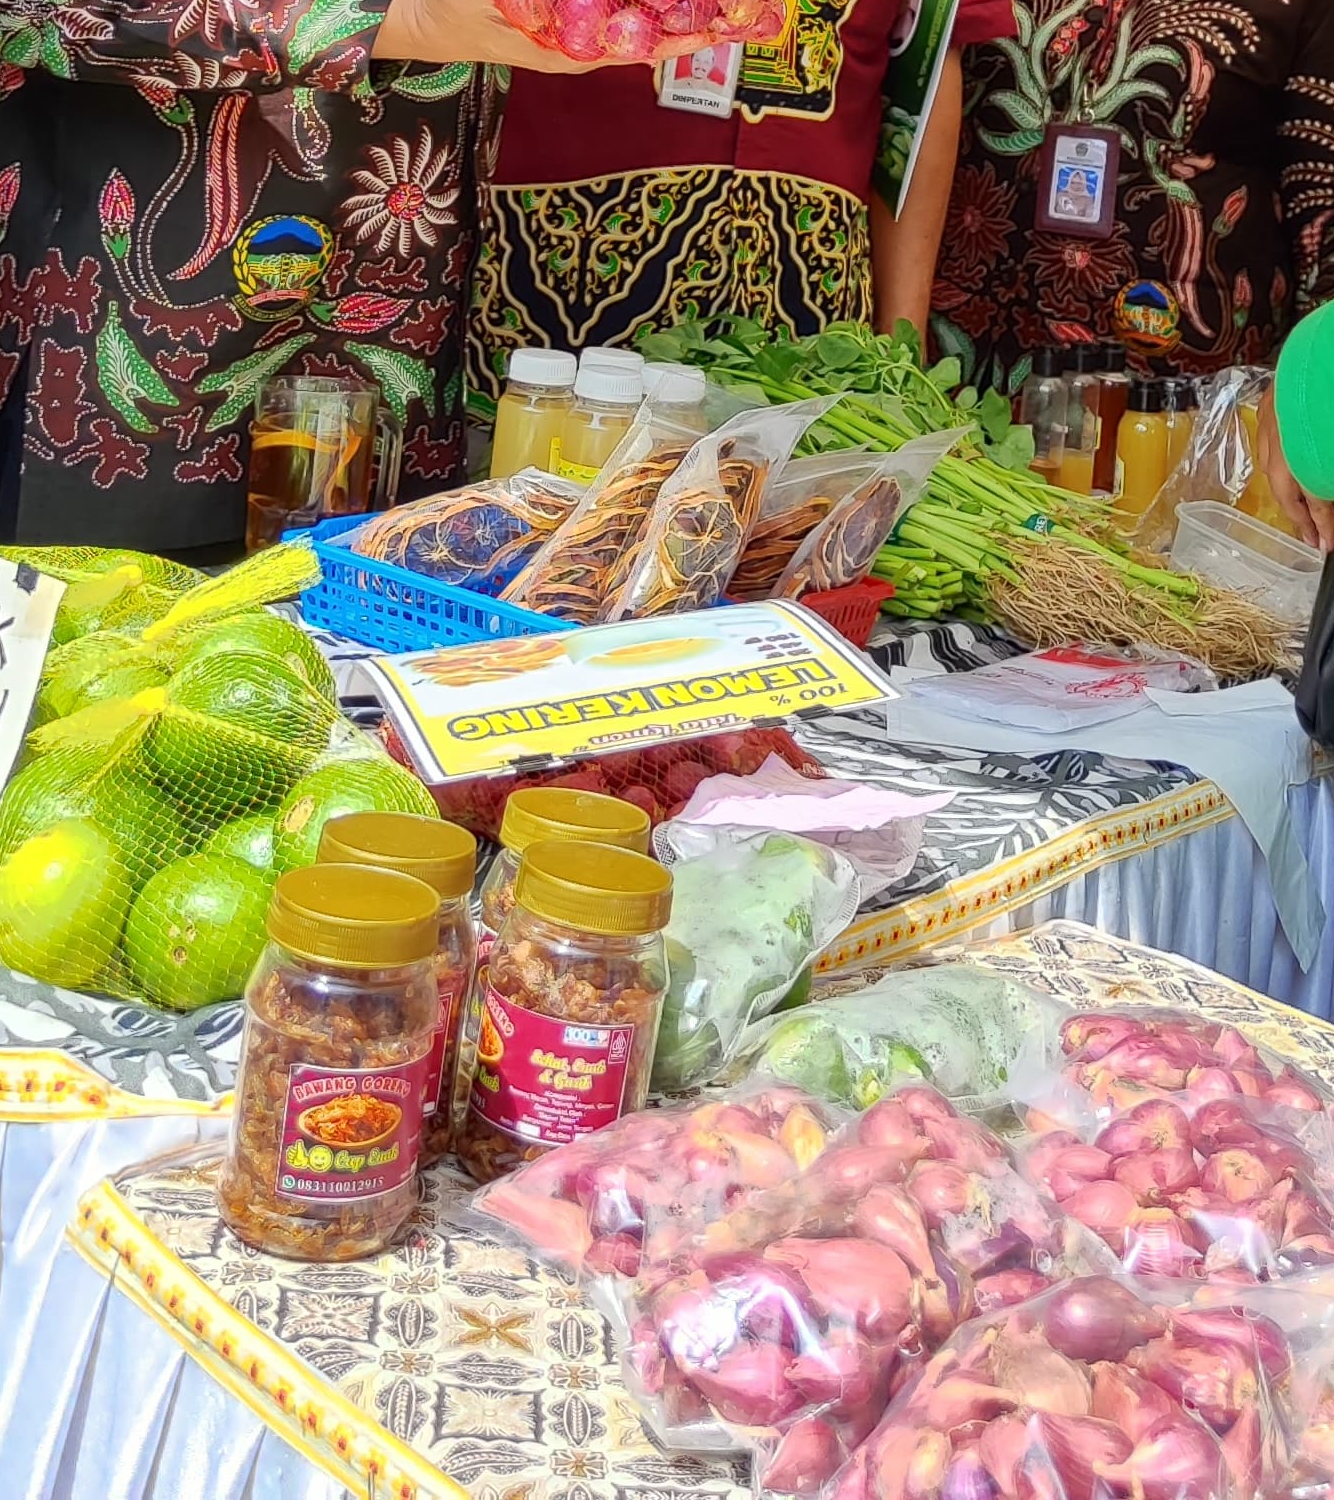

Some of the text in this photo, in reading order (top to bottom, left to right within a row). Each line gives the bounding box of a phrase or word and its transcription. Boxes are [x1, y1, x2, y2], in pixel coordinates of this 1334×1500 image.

[447, 657, 838, 741] LEMON KERING
[769, 683, 849, 707] 100 %
[294, 1076, 357, 1102] BAWANG
